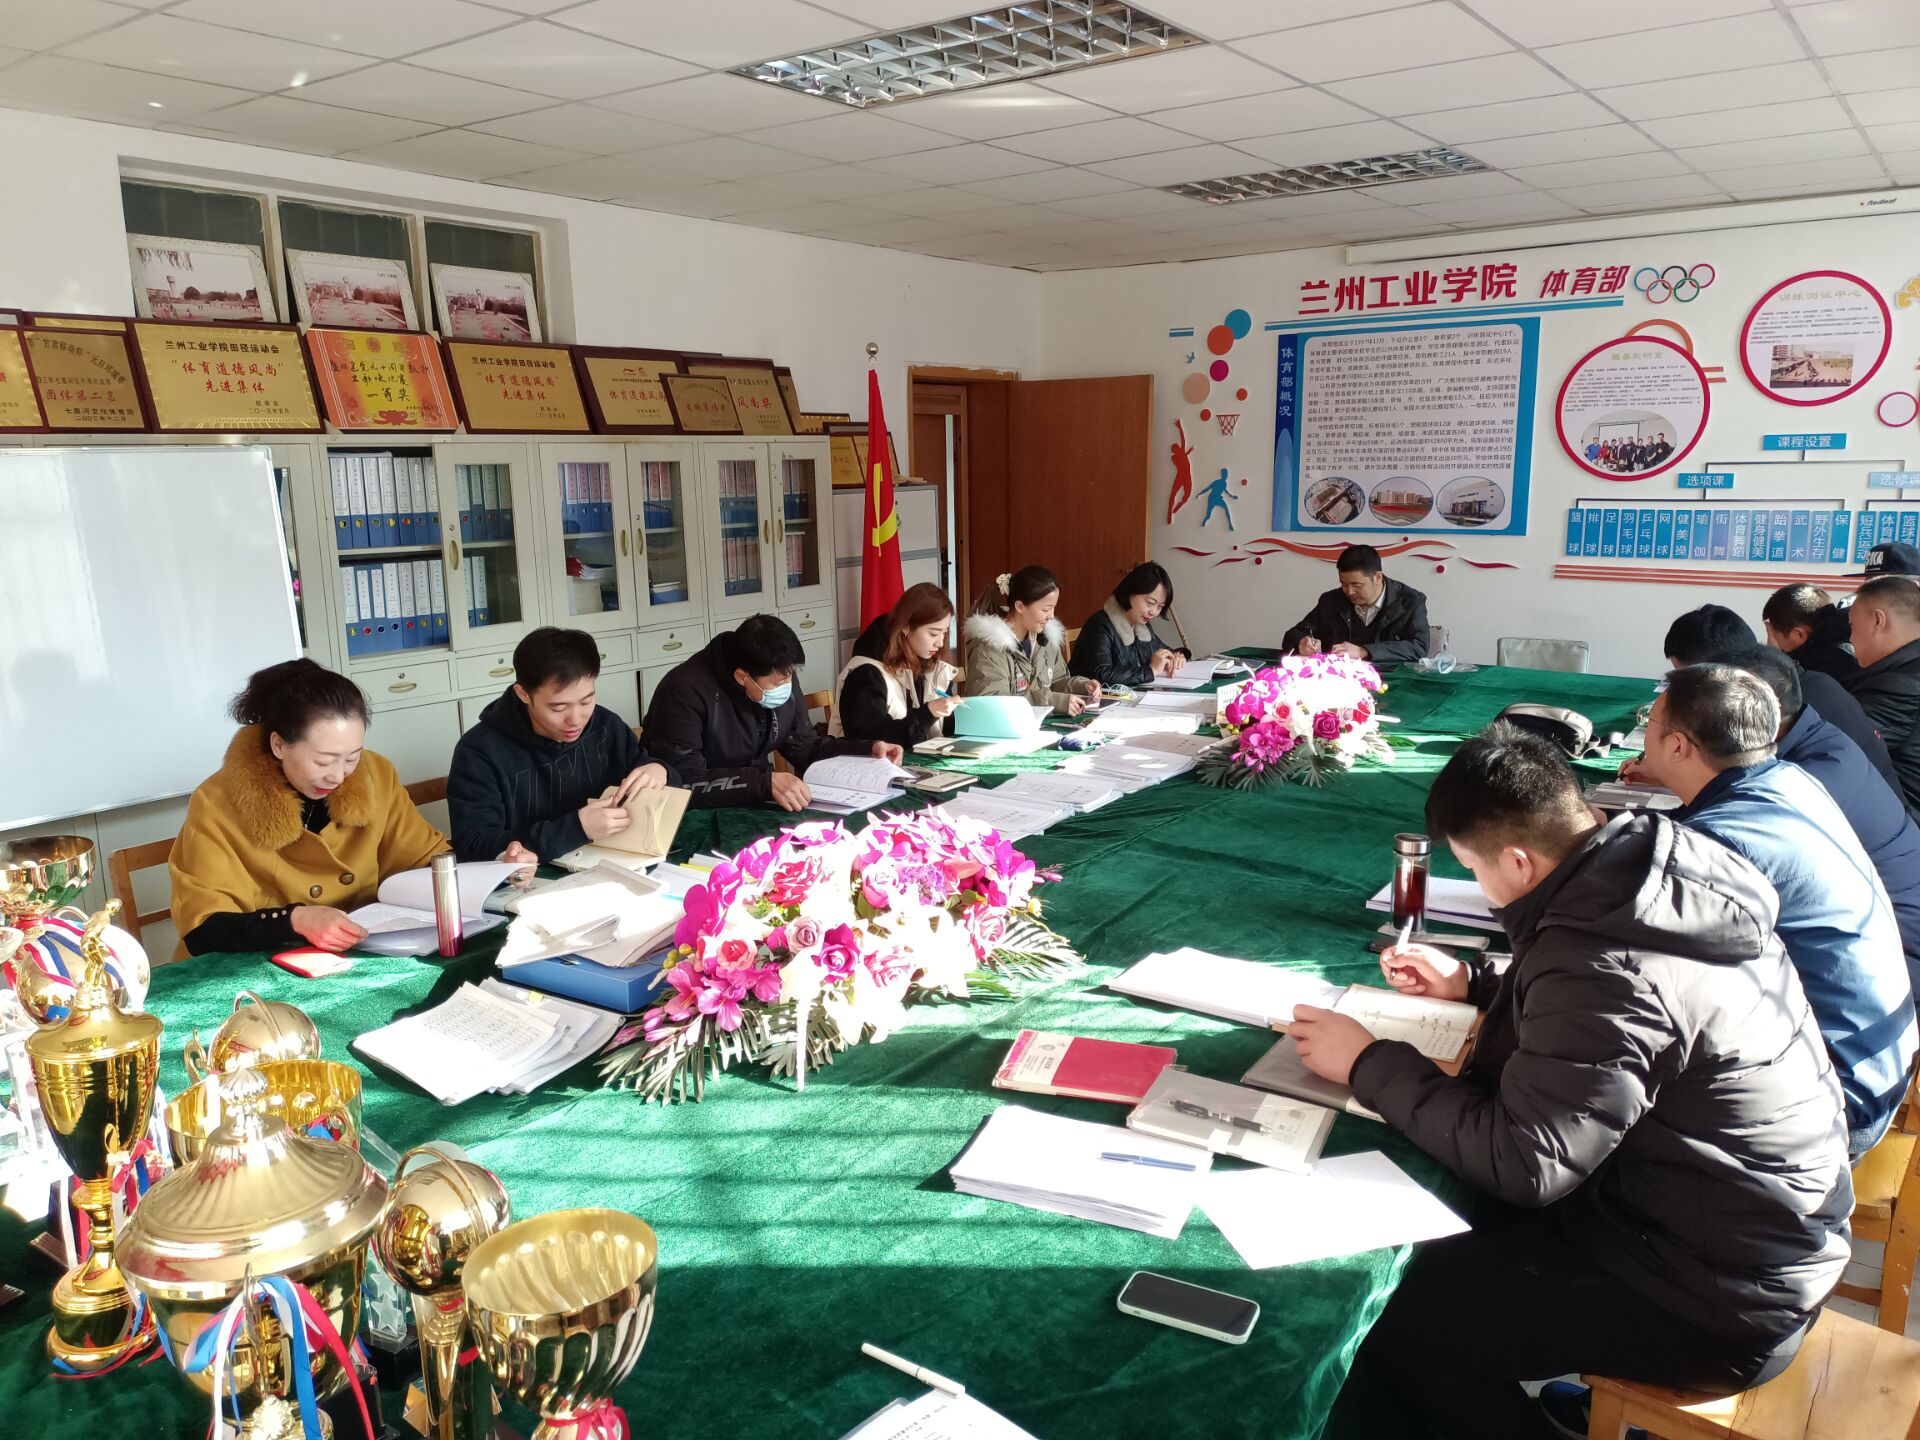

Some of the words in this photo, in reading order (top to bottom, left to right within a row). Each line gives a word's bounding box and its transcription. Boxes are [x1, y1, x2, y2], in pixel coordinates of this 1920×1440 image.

[1299, 263, 1517, 314] 兰州工业学院
[1539, 265, 1631, 299] 体育部
[165, 340, 280, 354] 兰州工业学院田径运动会
[472, 356, 556, 369] 兰州工业学院田径运动会
[47, 389, 116, 402] 团体第二名
[205, 379, 265, 394] 先进集体
[367, 387, 411, 402] 一等奖
[502, 388, 547, 401] 先进集体
[1279, 347, 1294, 417] 体育部概况
[1777, 436, 1832, 448] 课程设置
[1686, 475, 1725, 487] 选项课
[1568, 512, 1582, 552] 篮球
[1586, 512, 1600, 553] 排球
[1603, 512, 1618, 553] 足球
[1620, 513, 1635, 554] 羽毛球
[1638, 513, 1654, 555] 乒乓球
[1656, 513, 1672, 555] 网球
[1674, 513, 1690, 556] 健美操
[1694, 513, 1709, 557] 瑜伽
[1712, 513, 1729, 557] 街舞
[1732, 513, 1748, 557] 体育舞蹈
[1752, 513, 1768, 558] 健身健美
[1771, 513, 1788, 558] 跆拳道
[1791, 514, 1808, 559] 武术
[1812, 514, 1829, 559] 野外生存
[1832, 514, 1849, 559] 保健
